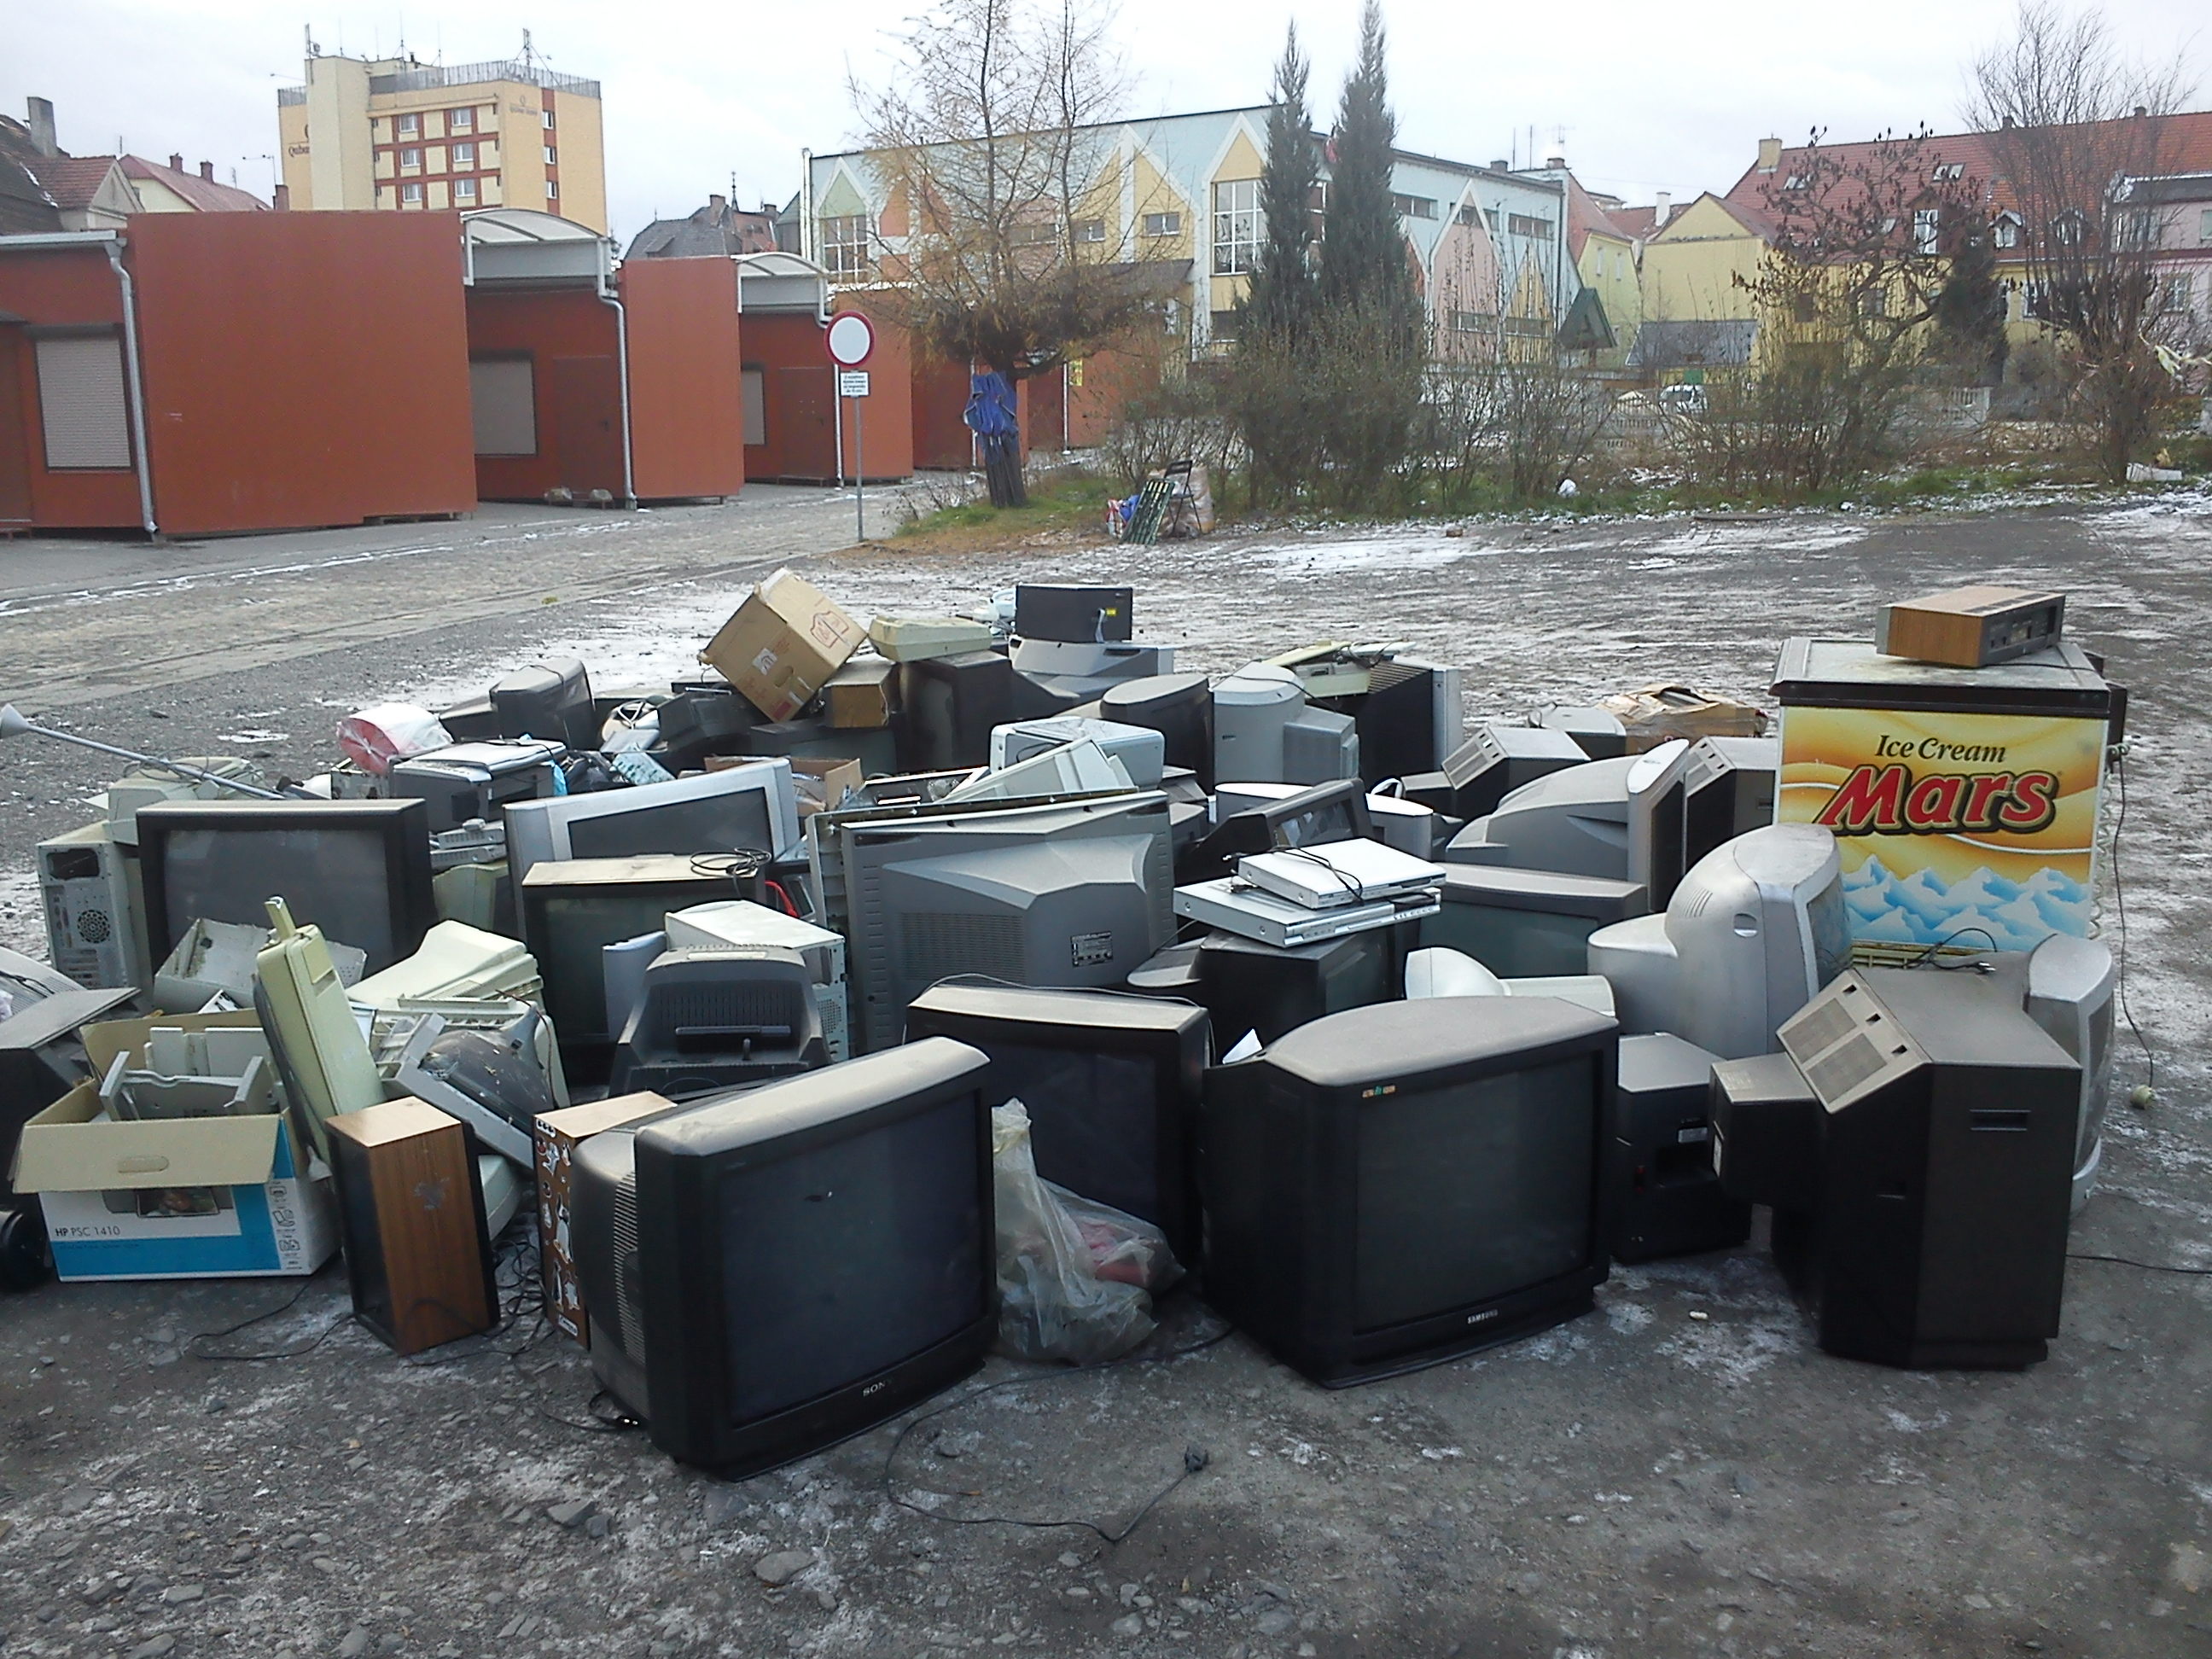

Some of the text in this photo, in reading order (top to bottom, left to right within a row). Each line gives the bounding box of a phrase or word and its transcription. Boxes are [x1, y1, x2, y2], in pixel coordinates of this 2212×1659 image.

[1875, 735, 2005, 763] Ice Cream
[1813, 764, 2059, 835] Mars
[55, 1225, 121, 1237] HP PSC 1410
